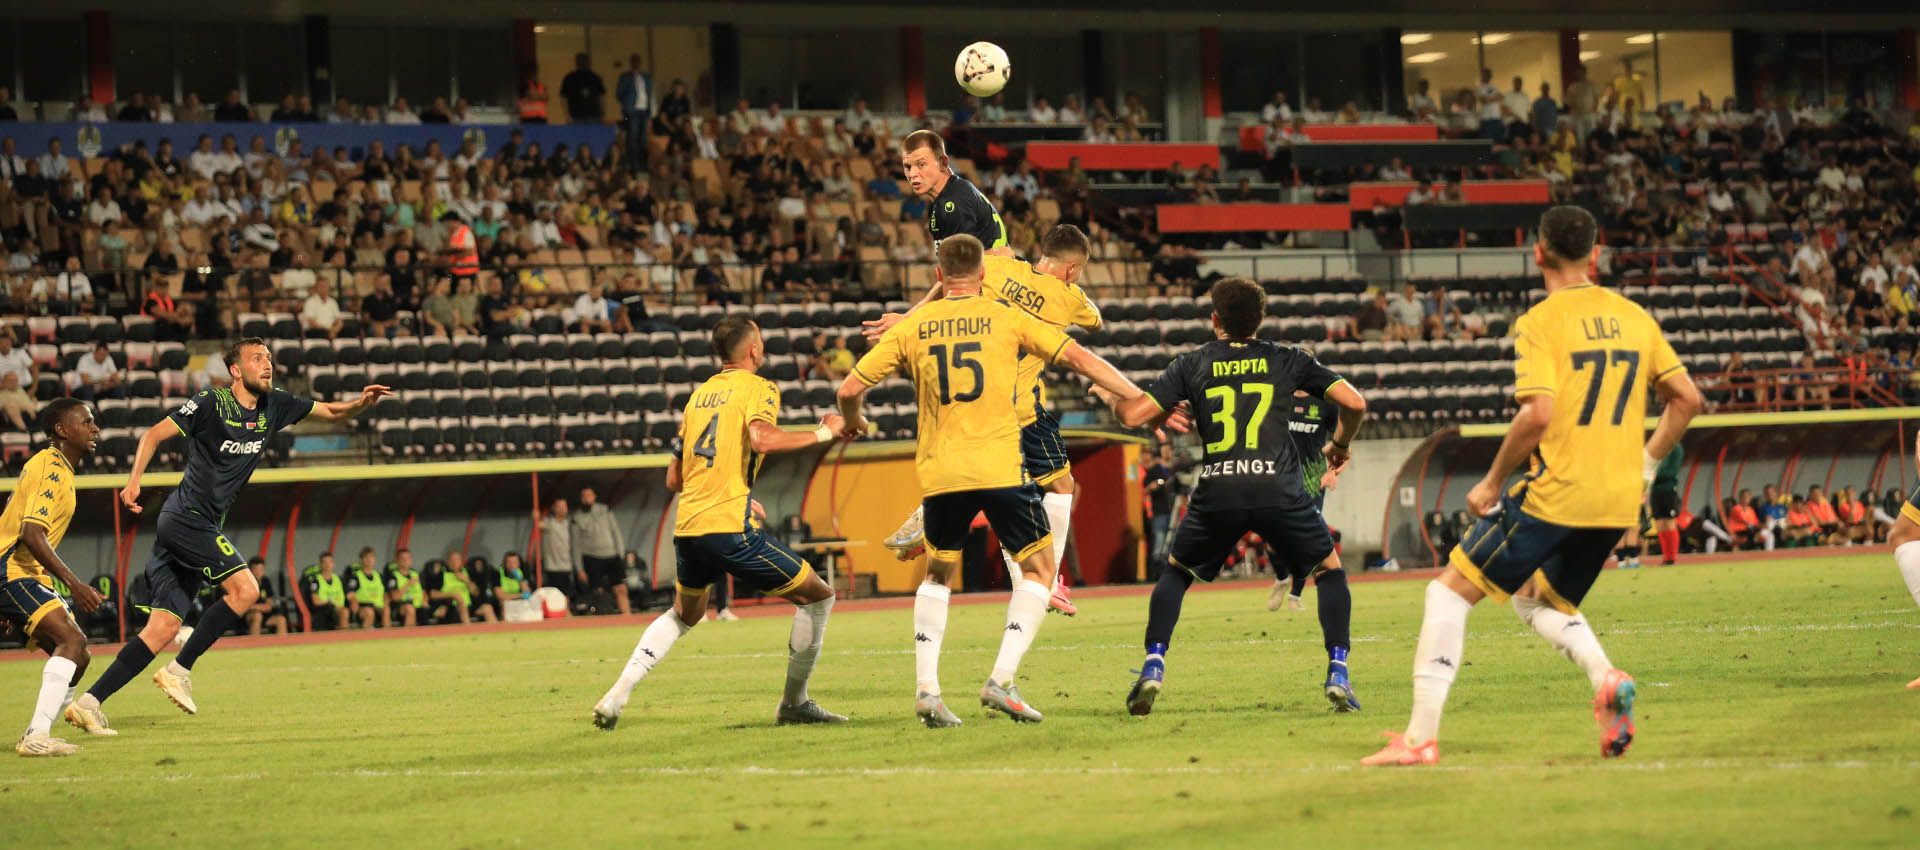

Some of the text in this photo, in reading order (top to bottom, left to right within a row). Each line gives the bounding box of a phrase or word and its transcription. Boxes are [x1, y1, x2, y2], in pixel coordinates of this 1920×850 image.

[1001, 277, 1045, 313] TRESA
[918, 317, 991, 339] EPITAUX
[1581, 317, 1622, 340] LILA
[928, 341, 984, 405] 15
[1212, 358, 1269, 377] ПУЭРТА
[1570, 349, 1639, 426] 77
[1205, 383, 1274, 454] 37
[220, 438, 265, 454] FONBE
[693, 412, 719, 468] 4
[1201, 459, 1276, 478] DZENGI
[215, 535, 235, 556] 6
